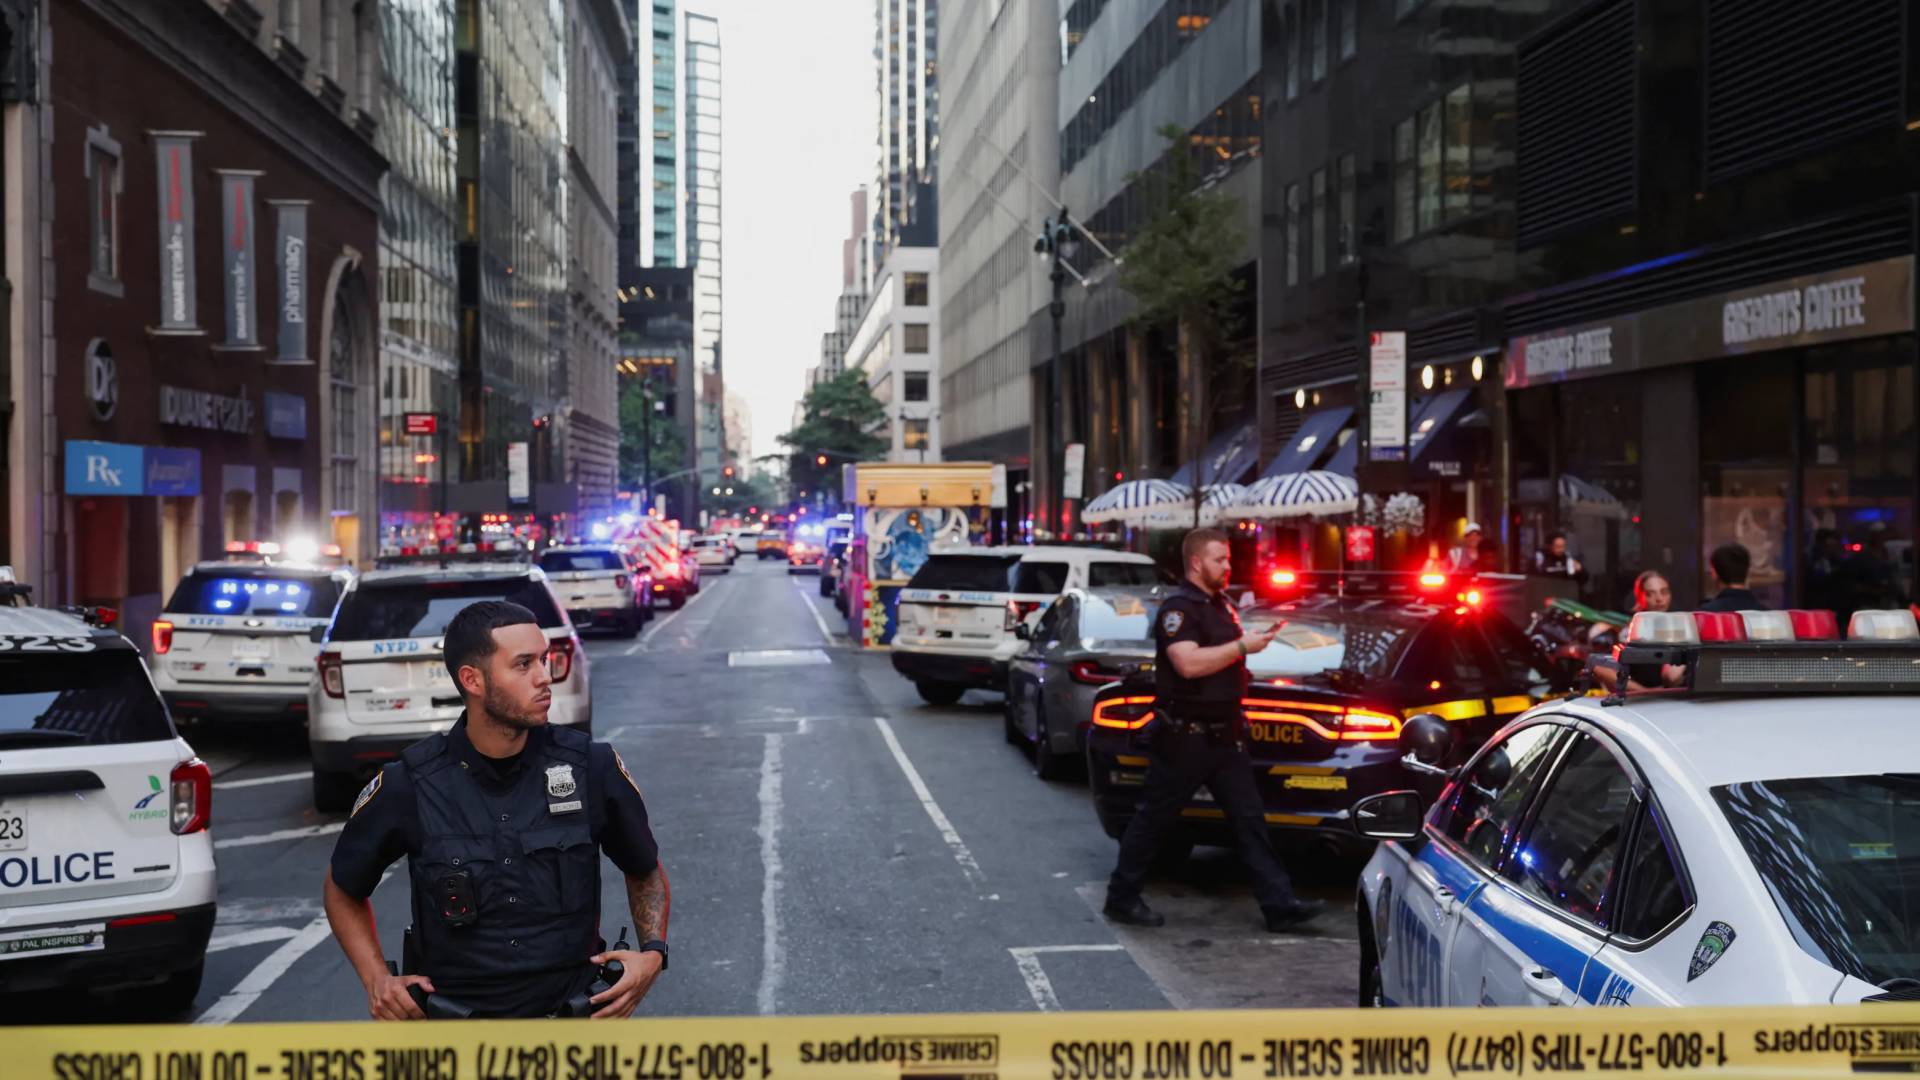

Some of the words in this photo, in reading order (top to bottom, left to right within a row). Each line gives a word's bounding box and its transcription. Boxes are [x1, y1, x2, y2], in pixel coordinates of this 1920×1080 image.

[286, 234, 304, 323] pharmacy
[1803, 277, 1865, 332] COFFEE
[374, 641, 419, 655] NYPD
[1250, 722, 1303, 743] OLICE
[129, 809, 168, 821] HYBRID
[22, 939, 39, 949] PAL
[41, 935, 85, 946] INSPIRES
[799, 1034, 923, 1067] stoppers
[928, 1041, 993, 1061] CRIME
[1352, 1036, 1430, 1076] CRIME
[1447, 1032, 1525, 1076] (8477)
[1532, 1031, 1728, 1071] 1-800-577-TIPS
[1754, 1024, 1873, 1056] stoppers
[53, 1052, 141, 1080] CROSS
[155, 1051, 203, 1080] NOT
[212, 1050, 247, 1080] DO
[281, 1048, 365, 1080] SCENE
[374, 1047, 457, 1080] CRIME
[477, 1043, 558, 1080] (8477)
[566, 1043, 771, 1080] 1-800-577-TIPS
[1051, 1041, 1133, 1080] CROSS
[1143, 1041, 1190, 1080] NOT
[1199, 1040, 1233, 1079] DO
[1264, 1038, 1343, 1078] SCENE
